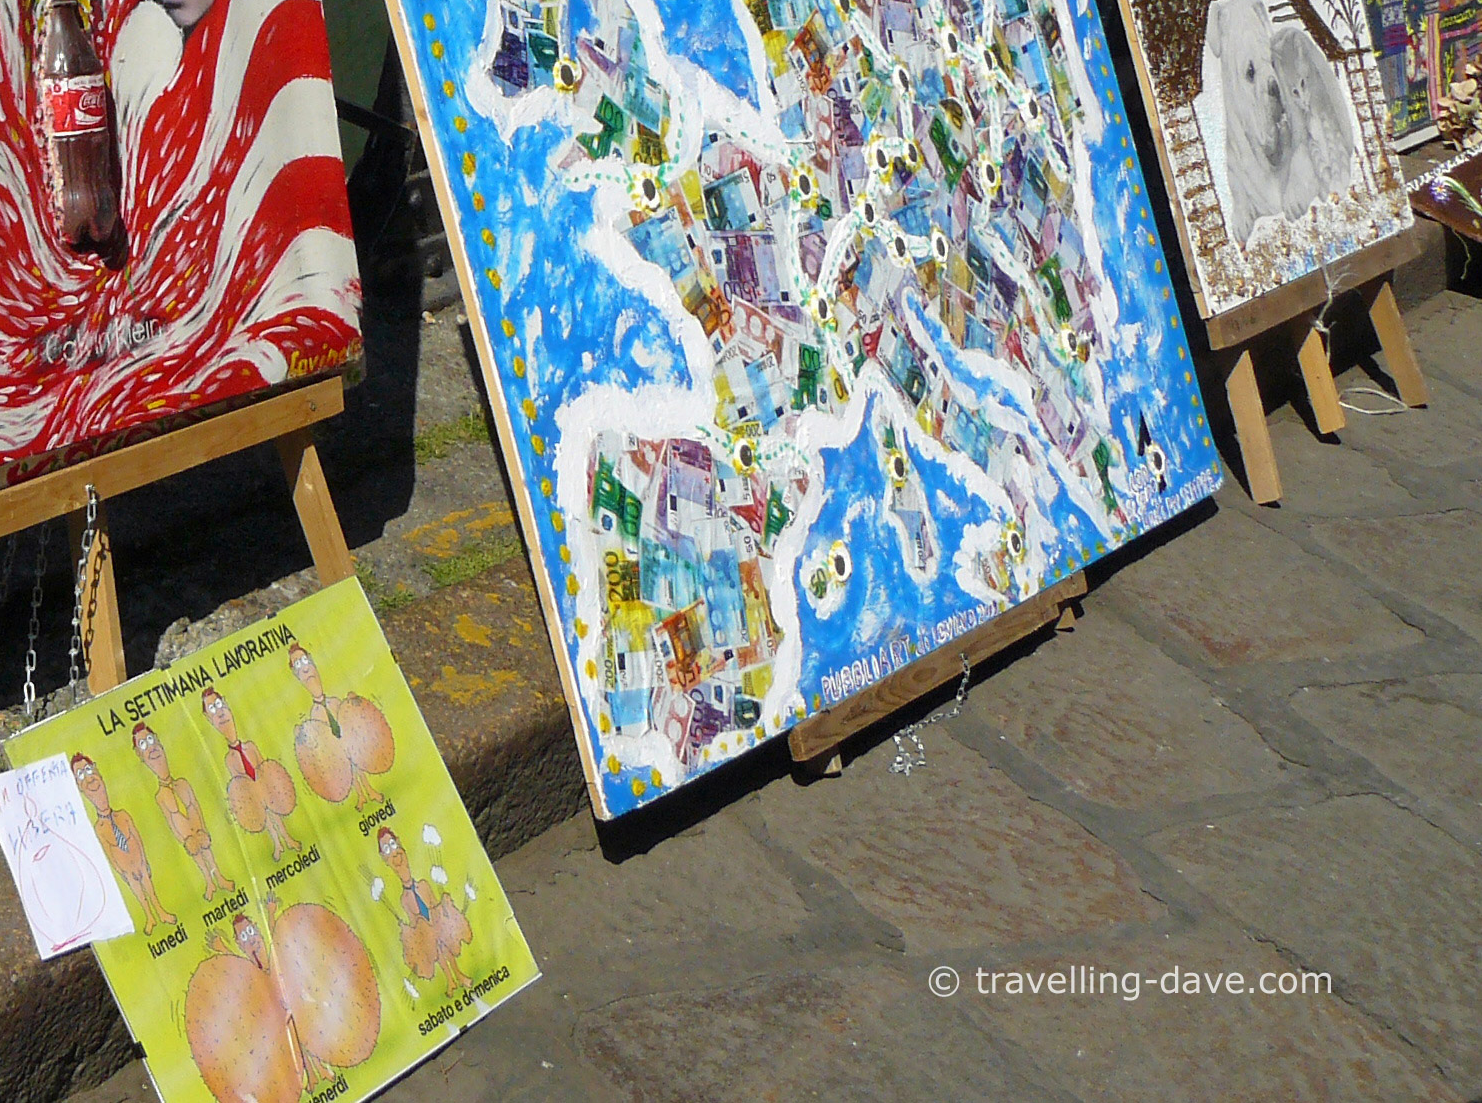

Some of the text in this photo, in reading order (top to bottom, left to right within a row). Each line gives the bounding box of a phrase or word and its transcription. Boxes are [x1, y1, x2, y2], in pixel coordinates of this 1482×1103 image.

[97, 622, 297, 737] LA SETTIMANA LAVORATIVA
[418, 965, 511, 1036] sabato e domenica
